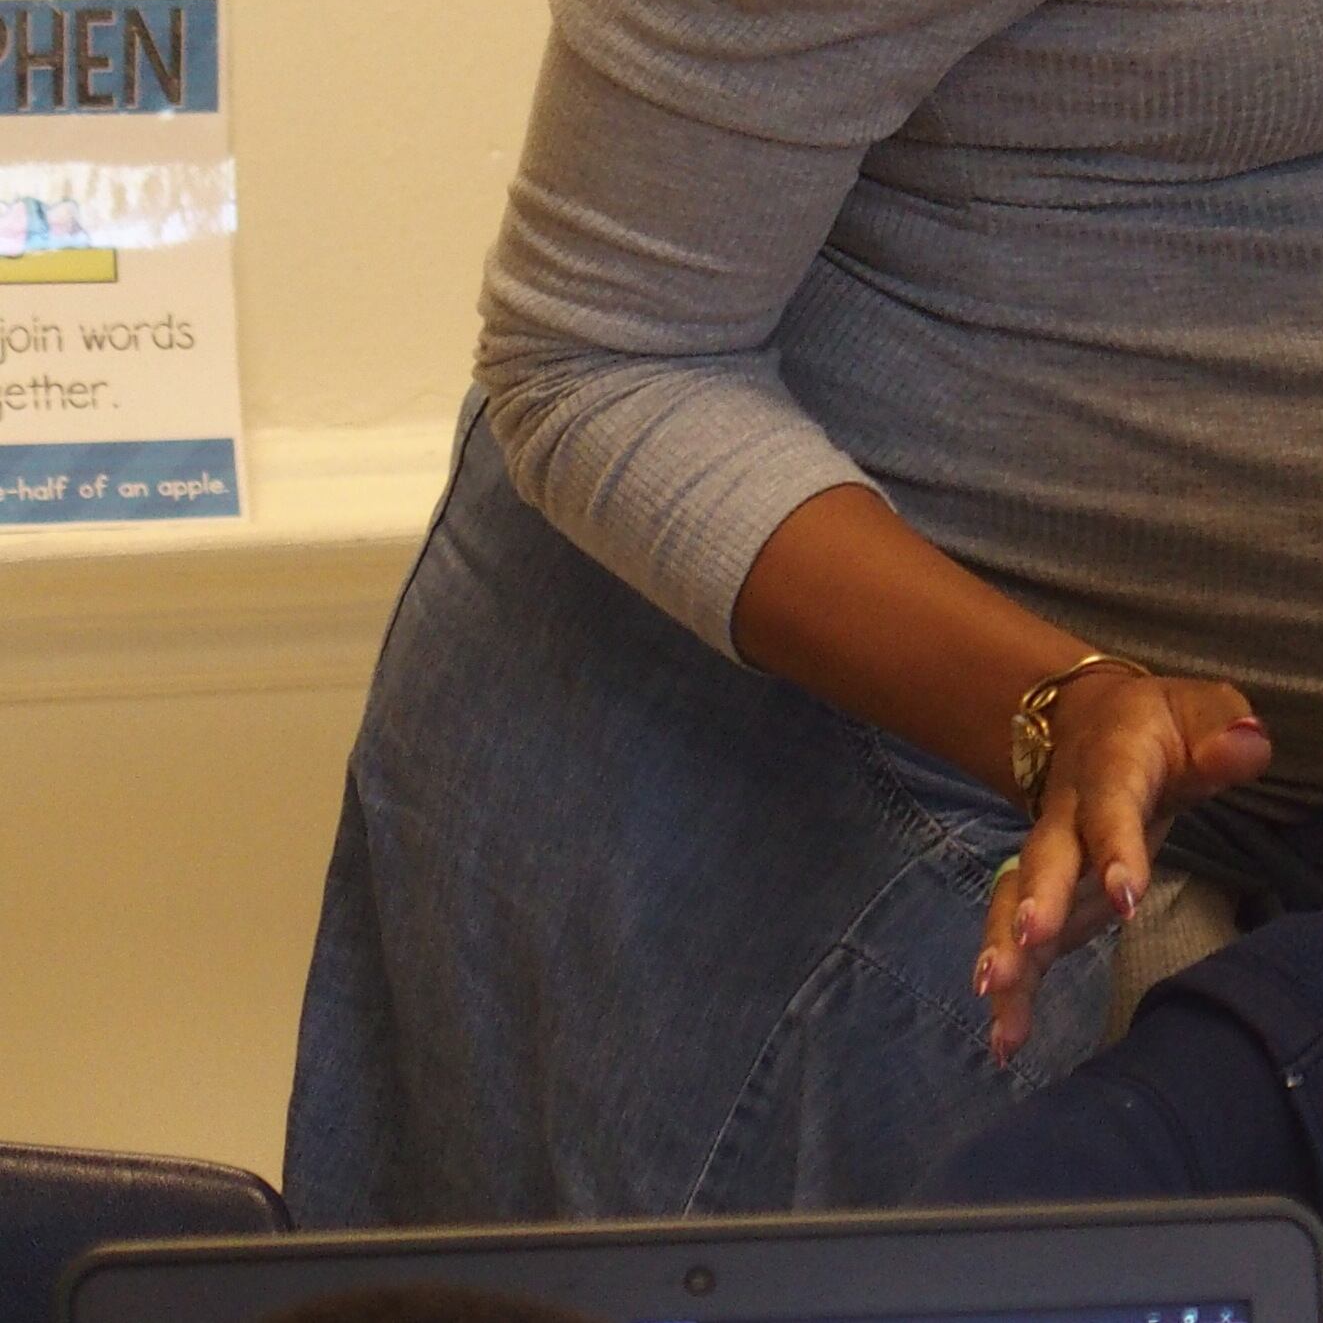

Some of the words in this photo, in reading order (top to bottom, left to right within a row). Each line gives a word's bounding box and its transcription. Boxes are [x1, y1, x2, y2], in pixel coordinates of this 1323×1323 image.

[81, 314, 196, 352] words
[79, 474, 109, 499] of
[118, 481, 149, 498] an
[157, 471, 230, 501] apple.
